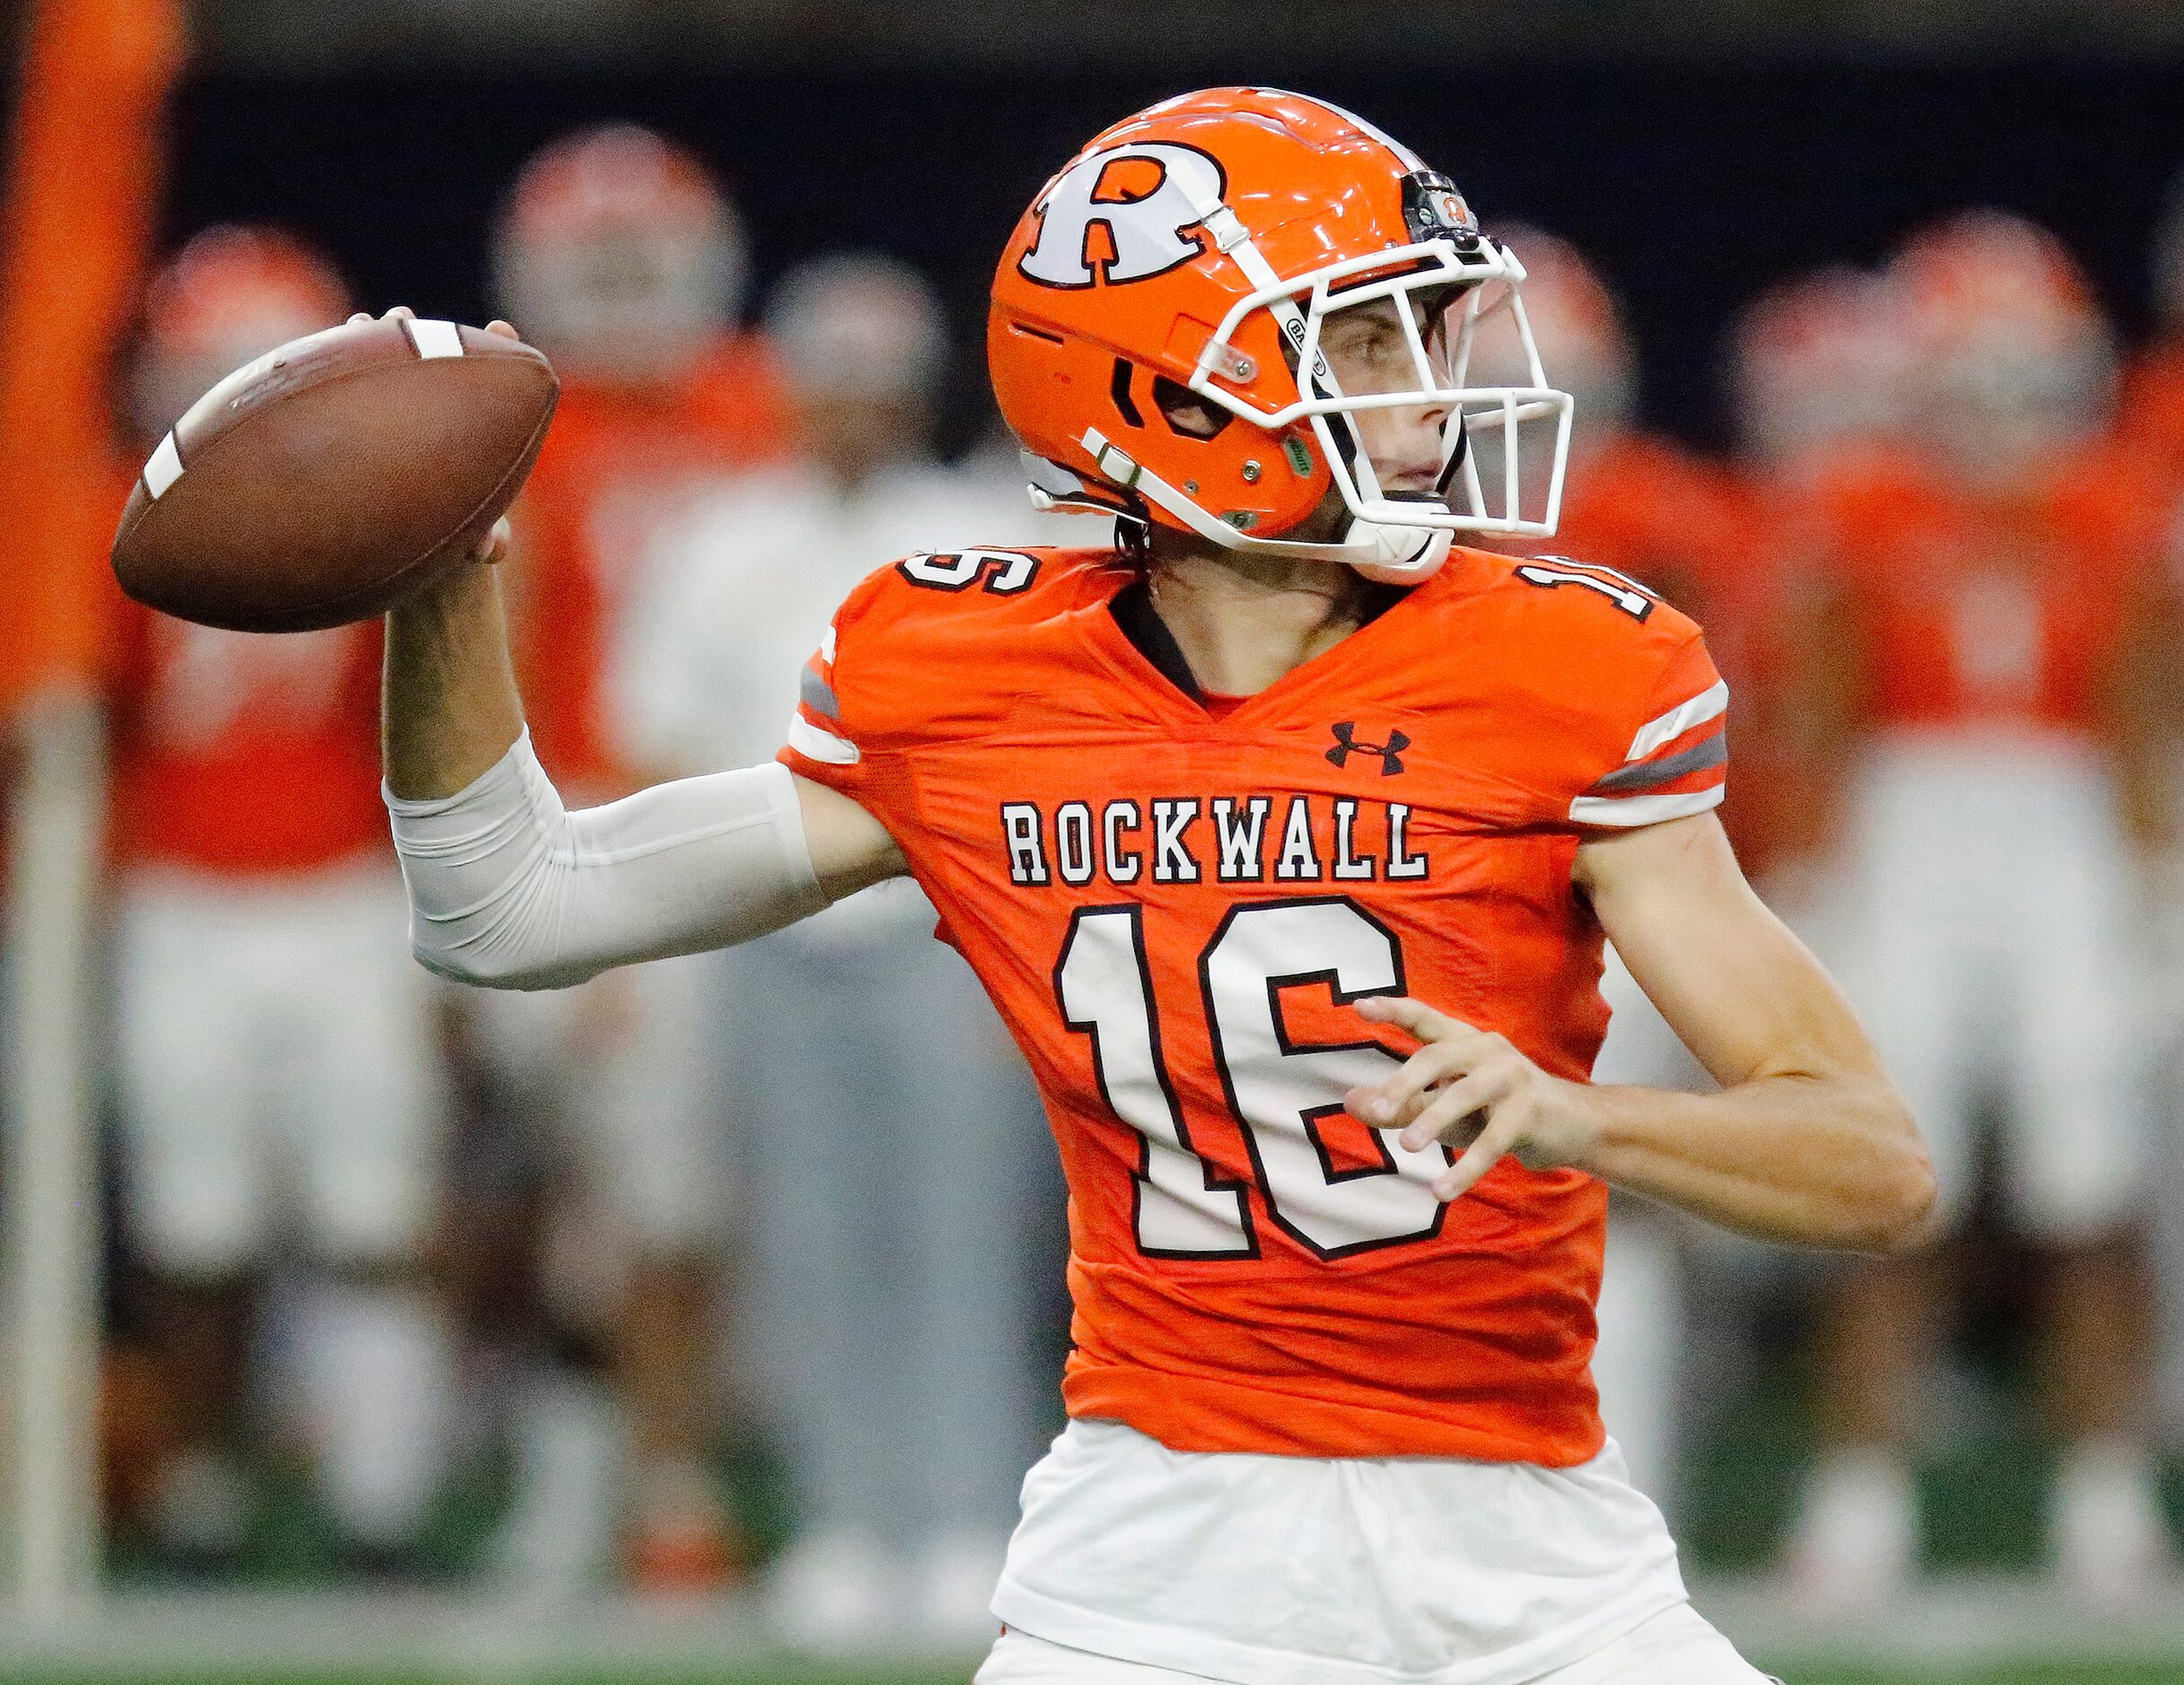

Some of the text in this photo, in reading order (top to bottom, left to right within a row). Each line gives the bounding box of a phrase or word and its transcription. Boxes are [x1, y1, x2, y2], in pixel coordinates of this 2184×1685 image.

[1017, 140, 1227, 291] R
[1290, 323, 1324, 371] BAE
[1512, 554, 1664, 624] 1
[1001, 796, 1429, 886] ROCKWALL
[1053, 895, 1454, 1261] 16
